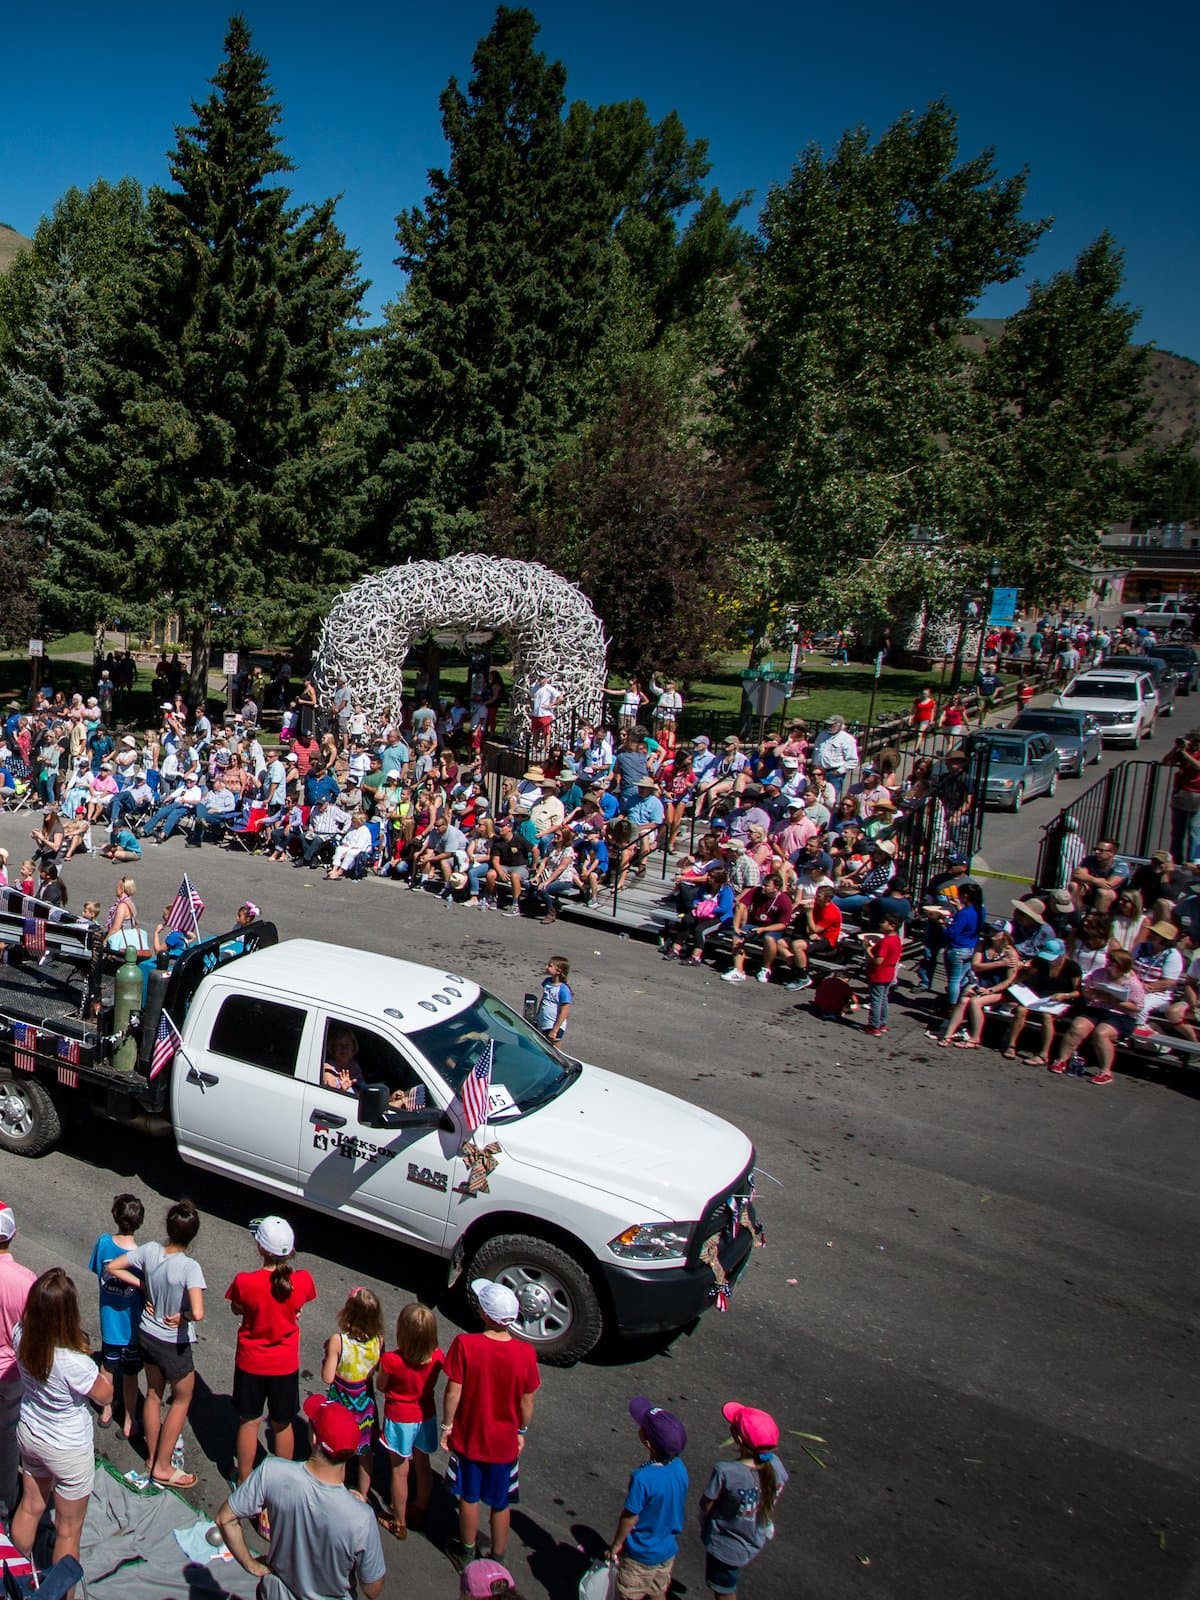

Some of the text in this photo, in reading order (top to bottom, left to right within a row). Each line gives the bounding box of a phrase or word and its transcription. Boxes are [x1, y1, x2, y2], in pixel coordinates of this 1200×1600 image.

[330, 1131, 396, 1159] JACKSON
[339, 1144, 377, 1164] HOLE
[408, 1163, 448, 1188] RAM
